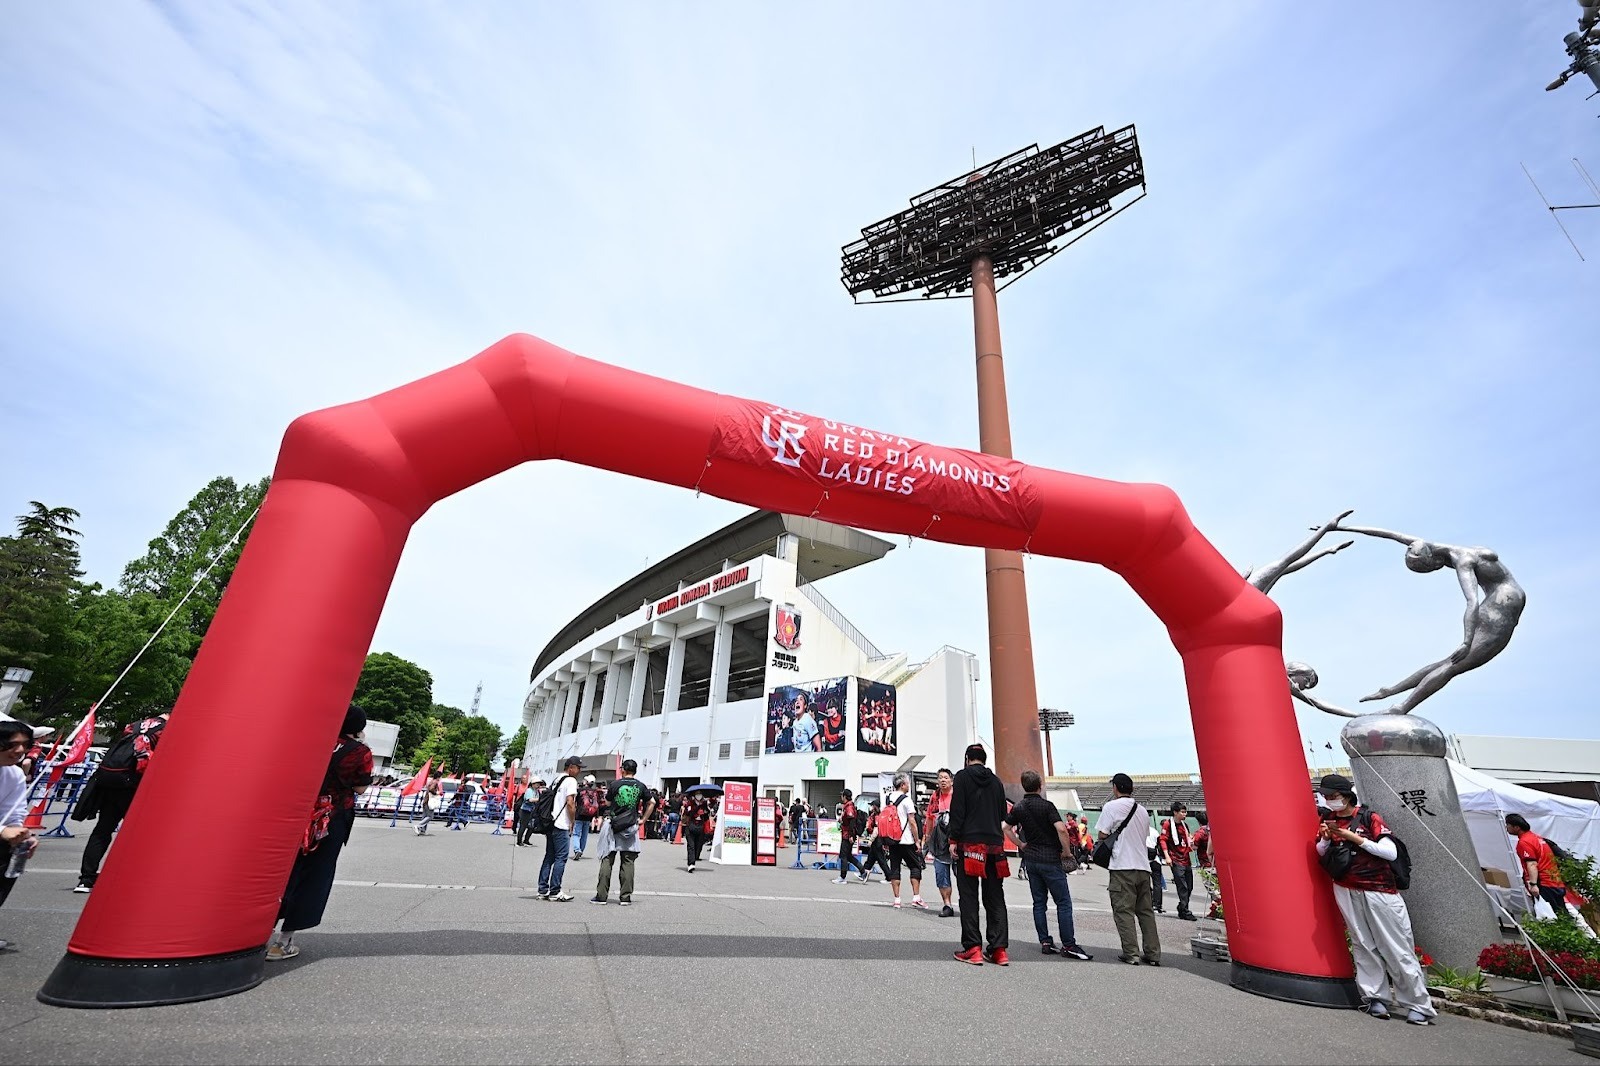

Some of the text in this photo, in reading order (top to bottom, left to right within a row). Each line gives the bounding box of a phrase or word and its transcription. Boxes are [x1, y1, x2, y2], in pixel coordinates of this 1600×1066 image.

[823, 419, 912, 448] URAWA
[818, 457, 916, 495] LADIES
[824, 433, 1011, 493] RED DIAMONDS
[657, 566, 749, 615] URAWA KOMABA STADIUM
[771, 659, 800, 673] スタジアム
[1398, 789, 1437, 817] 環
